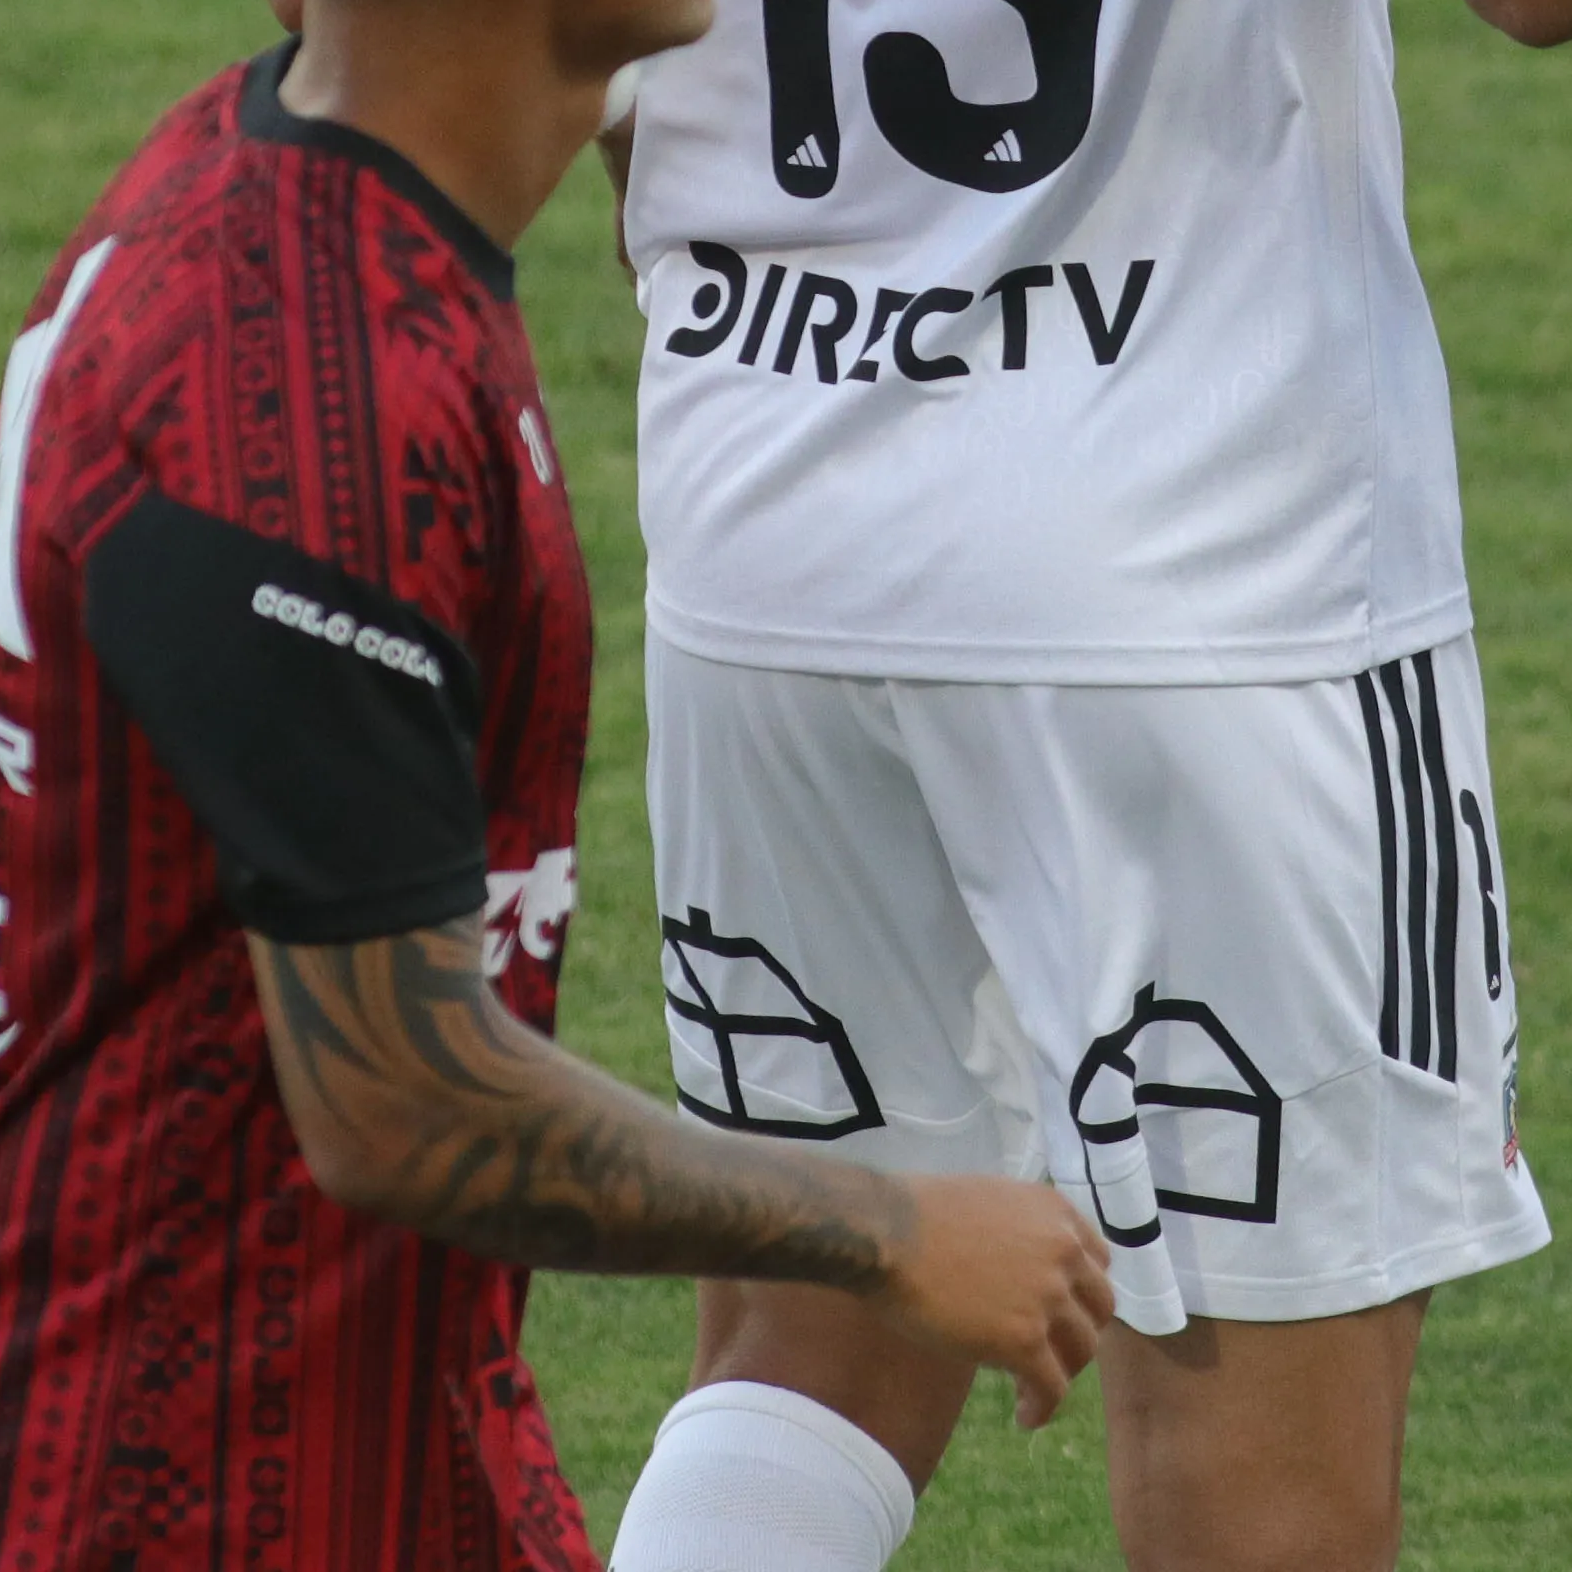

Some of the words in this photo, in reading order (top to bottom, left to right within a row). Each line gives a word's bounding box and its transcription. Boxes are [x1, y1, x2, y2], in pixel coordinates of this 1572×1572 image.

[665, 240, 1155, 385] DIRECTV
[251, 582, 357, 647] COLO
[1459, 788, 1502, 1002] 1
